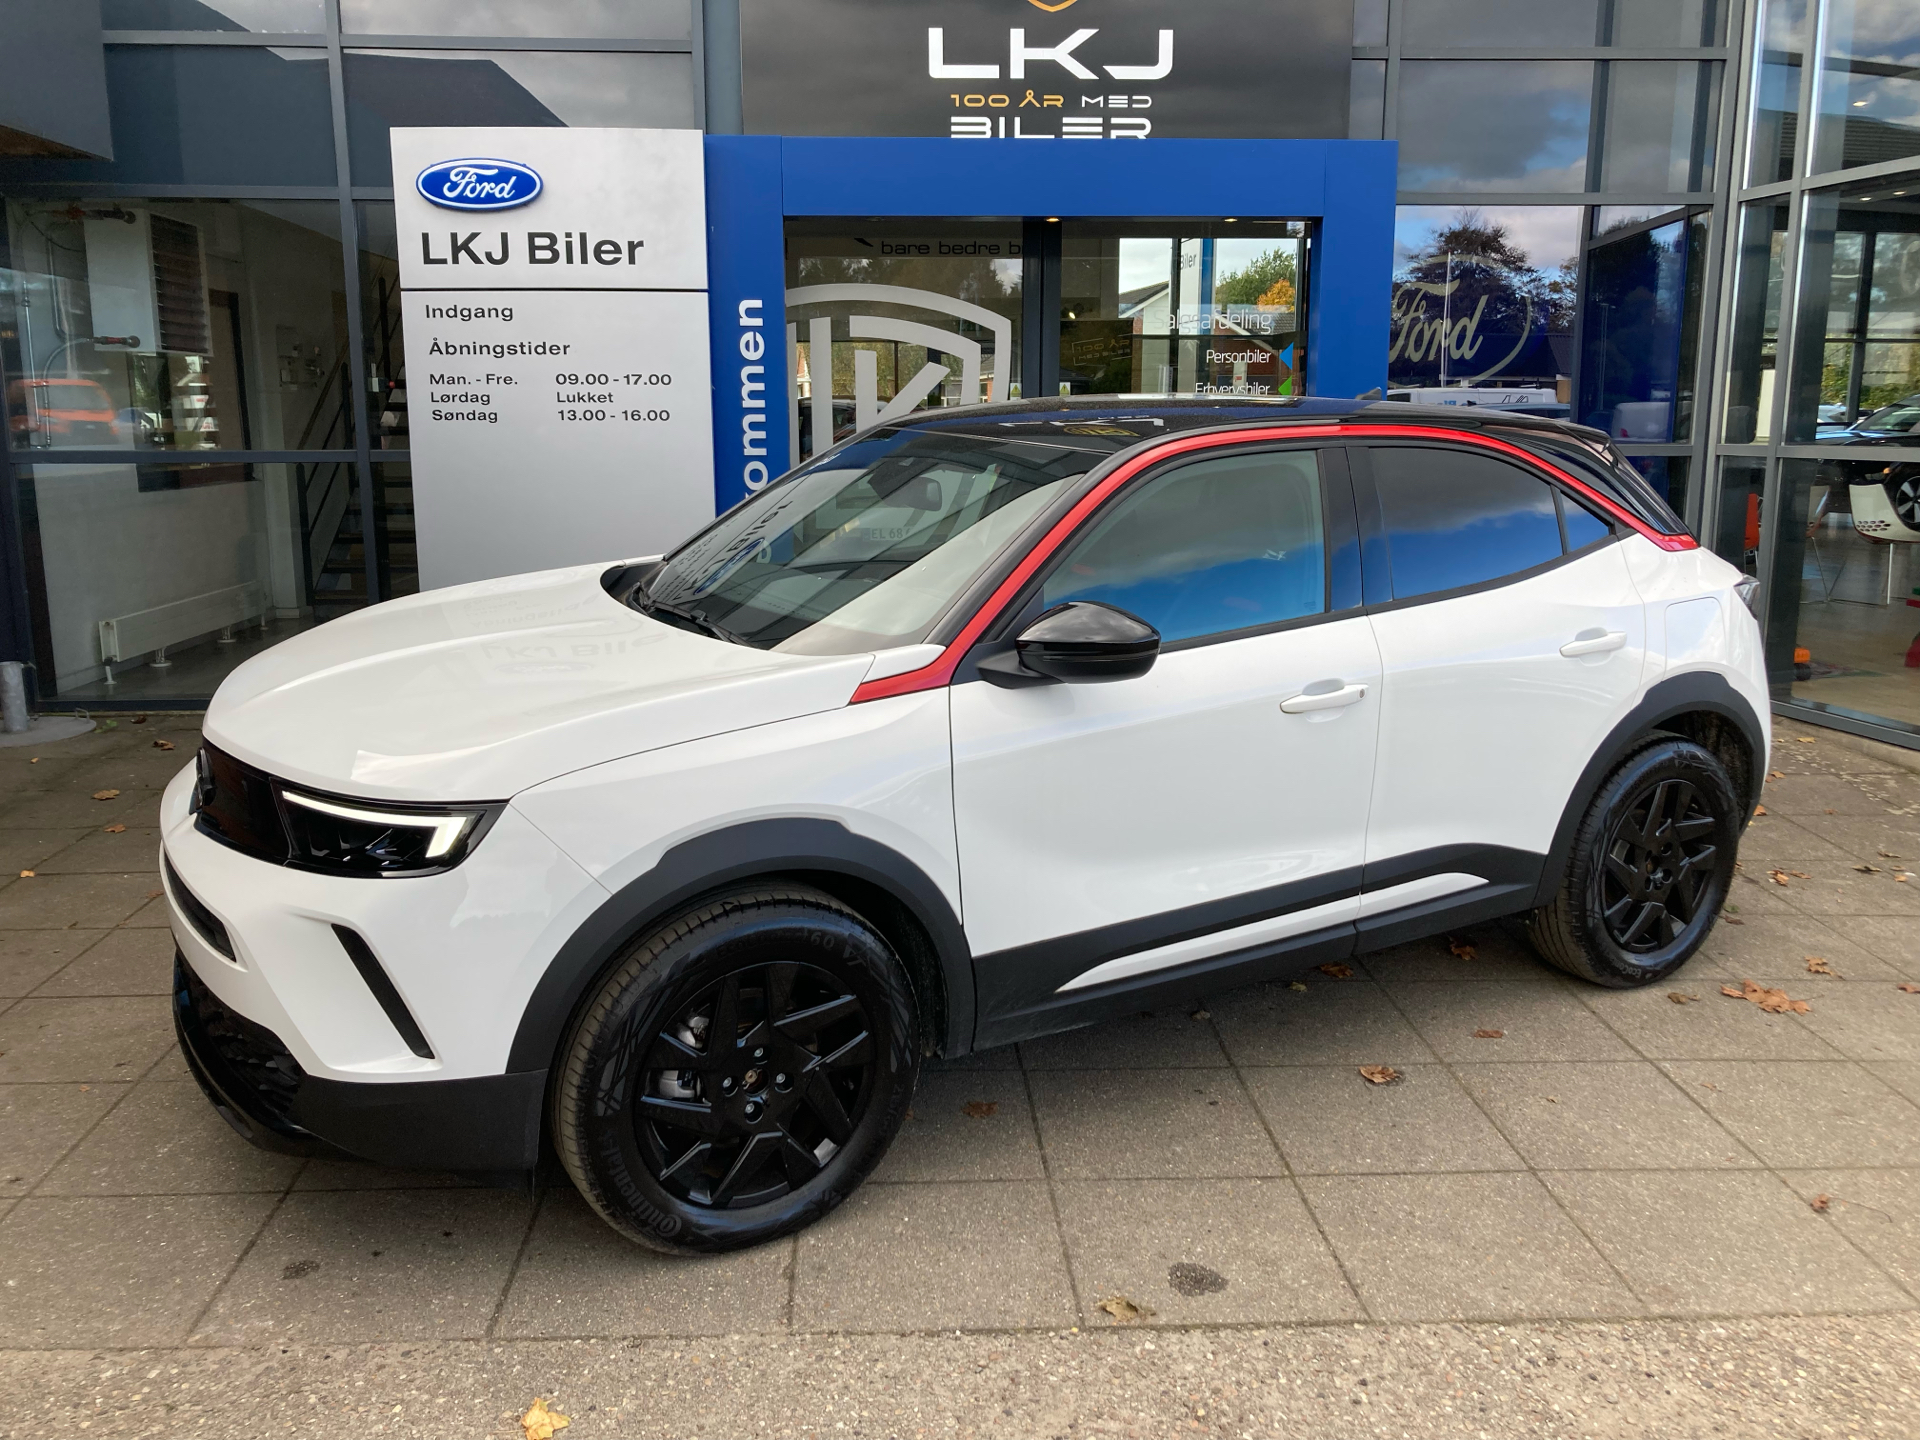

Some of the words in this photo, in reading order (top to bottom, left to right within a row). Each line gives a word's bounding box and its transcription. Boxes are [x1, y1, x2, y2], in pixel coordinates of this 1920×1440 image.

[928, 27, 1174, 80] LKJ
[950, 93, 1010, 108] 100
[1018, 89, 1065, 108] ÅR
[1081, 95, 1152, 108] MED
[950, 116, 1152, 139] BILER
[443, 166, 516, 199] Ford
[421, 231, 510, 266] LKJ
[527, 231, 645, 266] Biler
[881, 241, 930, 255] bare
[938, 241, 1000, 255] bedre
[425, 304, 514, 322] Indgang
[1154, 308, 1273, 334] Salgsafdeling
[1388, 279, 1489, 364] Ford
[429, 337, 571, 358] Åbningstider
[1206, 349, 1271, 364] Personbiler
[429, 373, 472, 385] Man.
[486, 373, 518, 386] Fre.
[555, 373, 609, 386] 09.00
[623, 373, 672, 386] 17.00
[430, 391, 491, 406] Lørdag
[556, 391, 614, 403] Lukket
[738, 299, 769, 498] ommen
[432, 409, 498, 423] Søndag
[557, 409, 606, 421] 13.00
[622, 409, 671, 421] 16.00
[871, 528, 886, 539] EL
